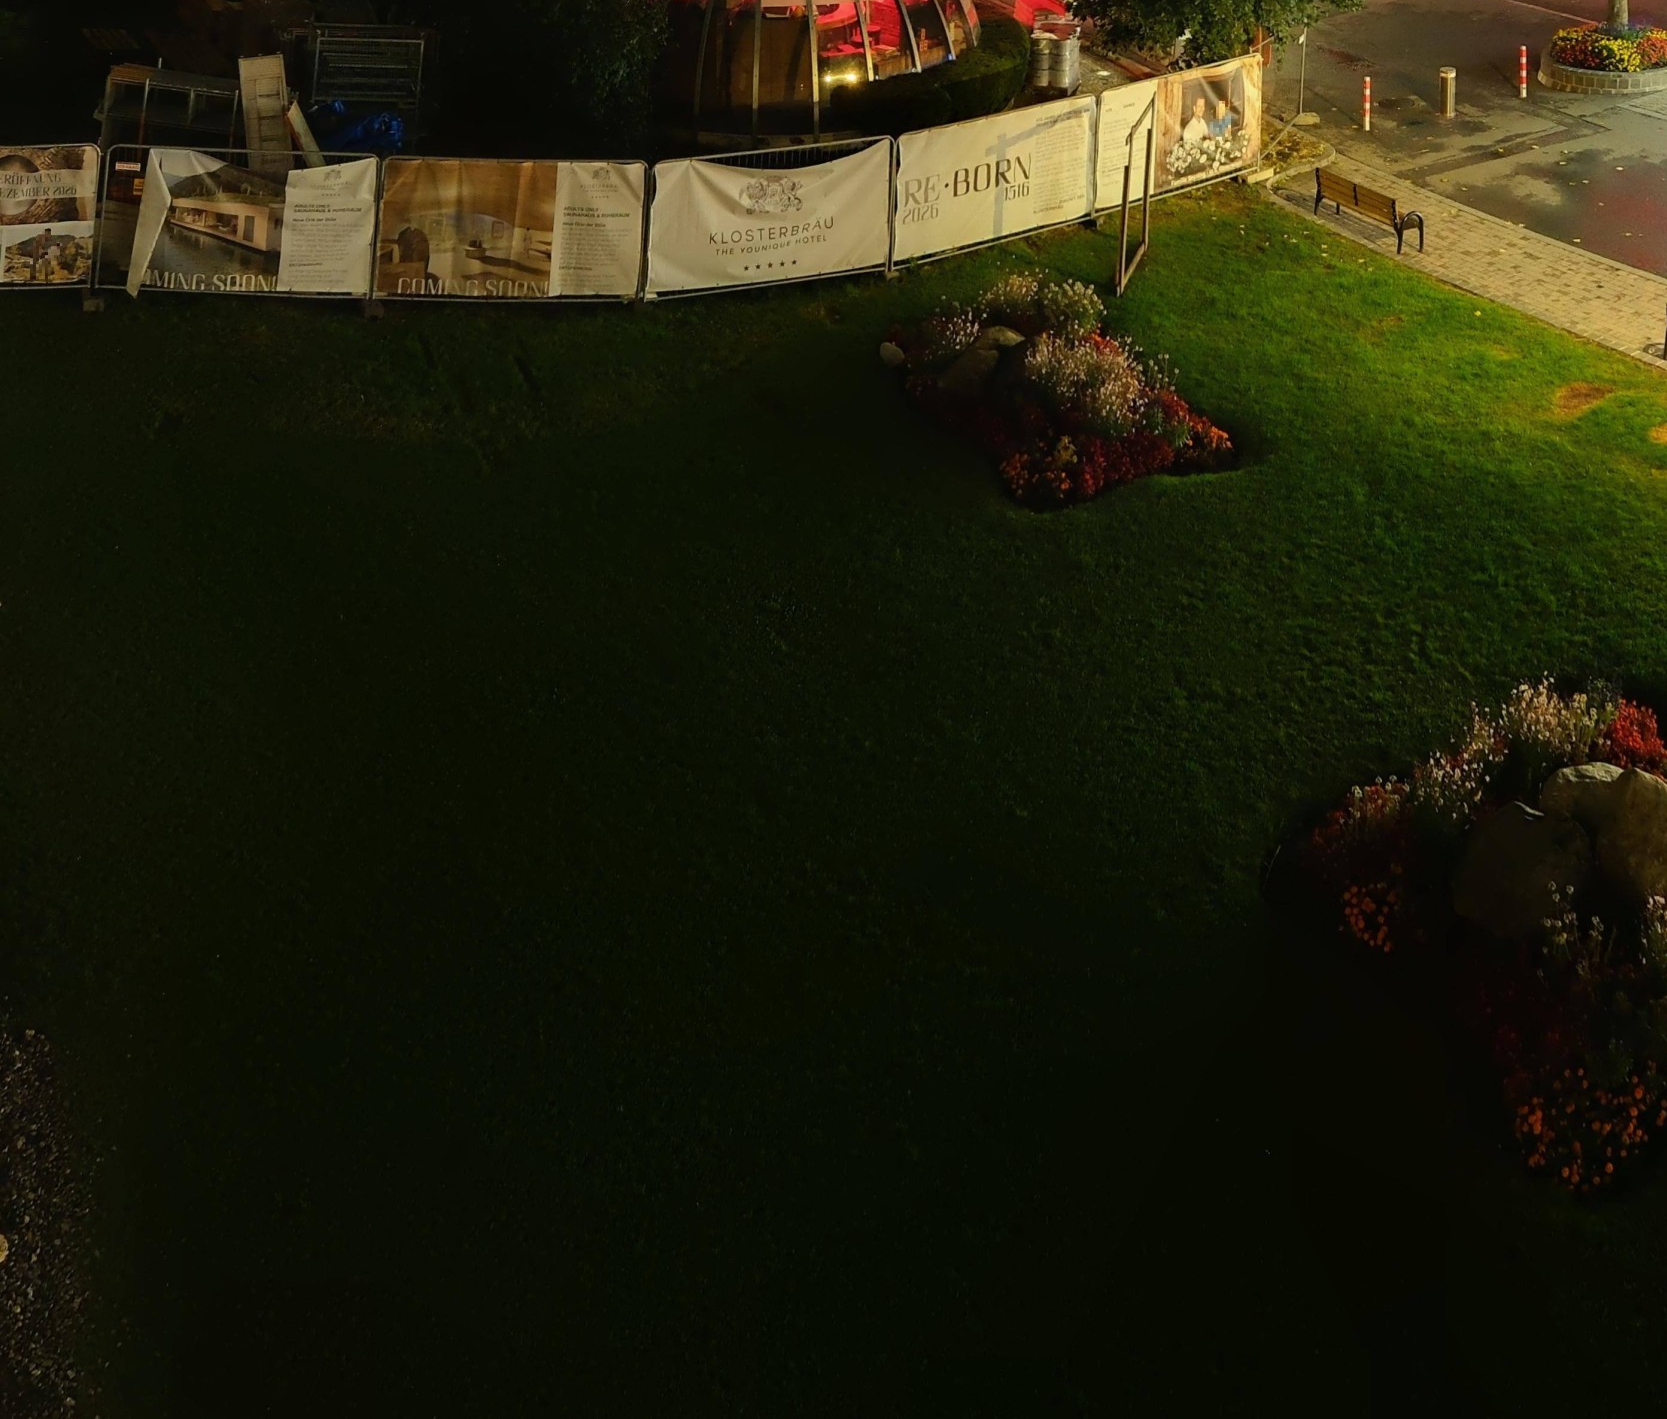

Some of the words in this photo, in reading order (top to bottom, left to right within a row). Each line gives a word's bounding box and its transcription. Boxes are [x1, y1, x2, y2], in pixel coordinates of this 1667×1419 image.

[1005, 181, 1030, 202] 1516
[902, 203, 939, 225] 2026
[709, 216, 834, 245] KLOSTERBRÄU
[715, 248, 734, 256] THE
[740, 241, 791, 255] YOUNIQUE
[795, 234, 827, 245] HOTEL
